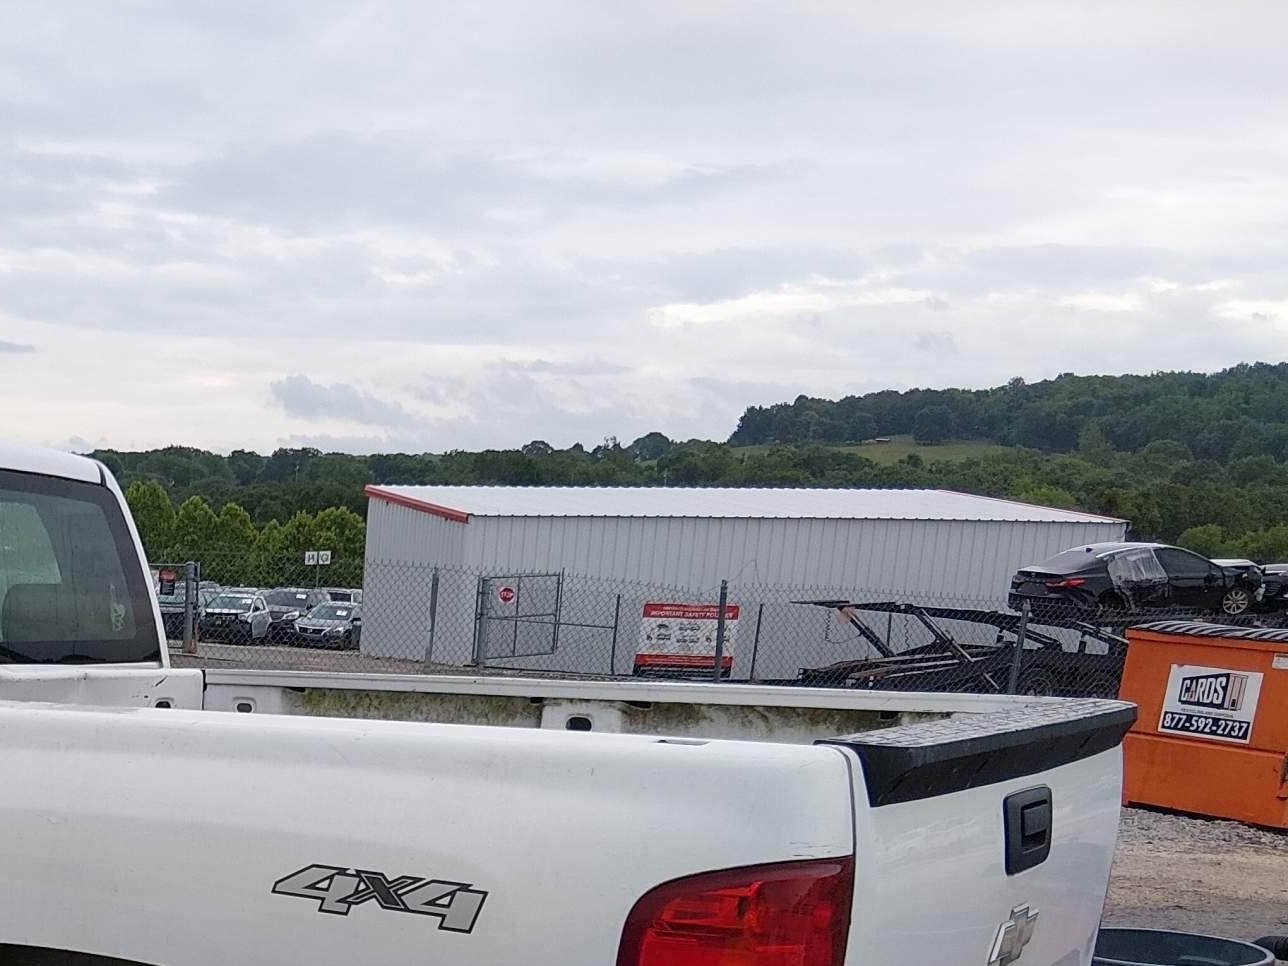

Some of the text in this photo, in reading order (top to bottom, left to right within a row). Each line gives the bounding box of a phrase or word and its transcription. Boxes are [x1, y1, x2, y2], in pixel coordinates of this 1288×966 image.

[307, 553, 315, 563] H
[1180, 676, 1227, 705] CARDS
[1163, 712, 1248, 737] 877-592-2737
[271, 863, 489, 934] 4X4
